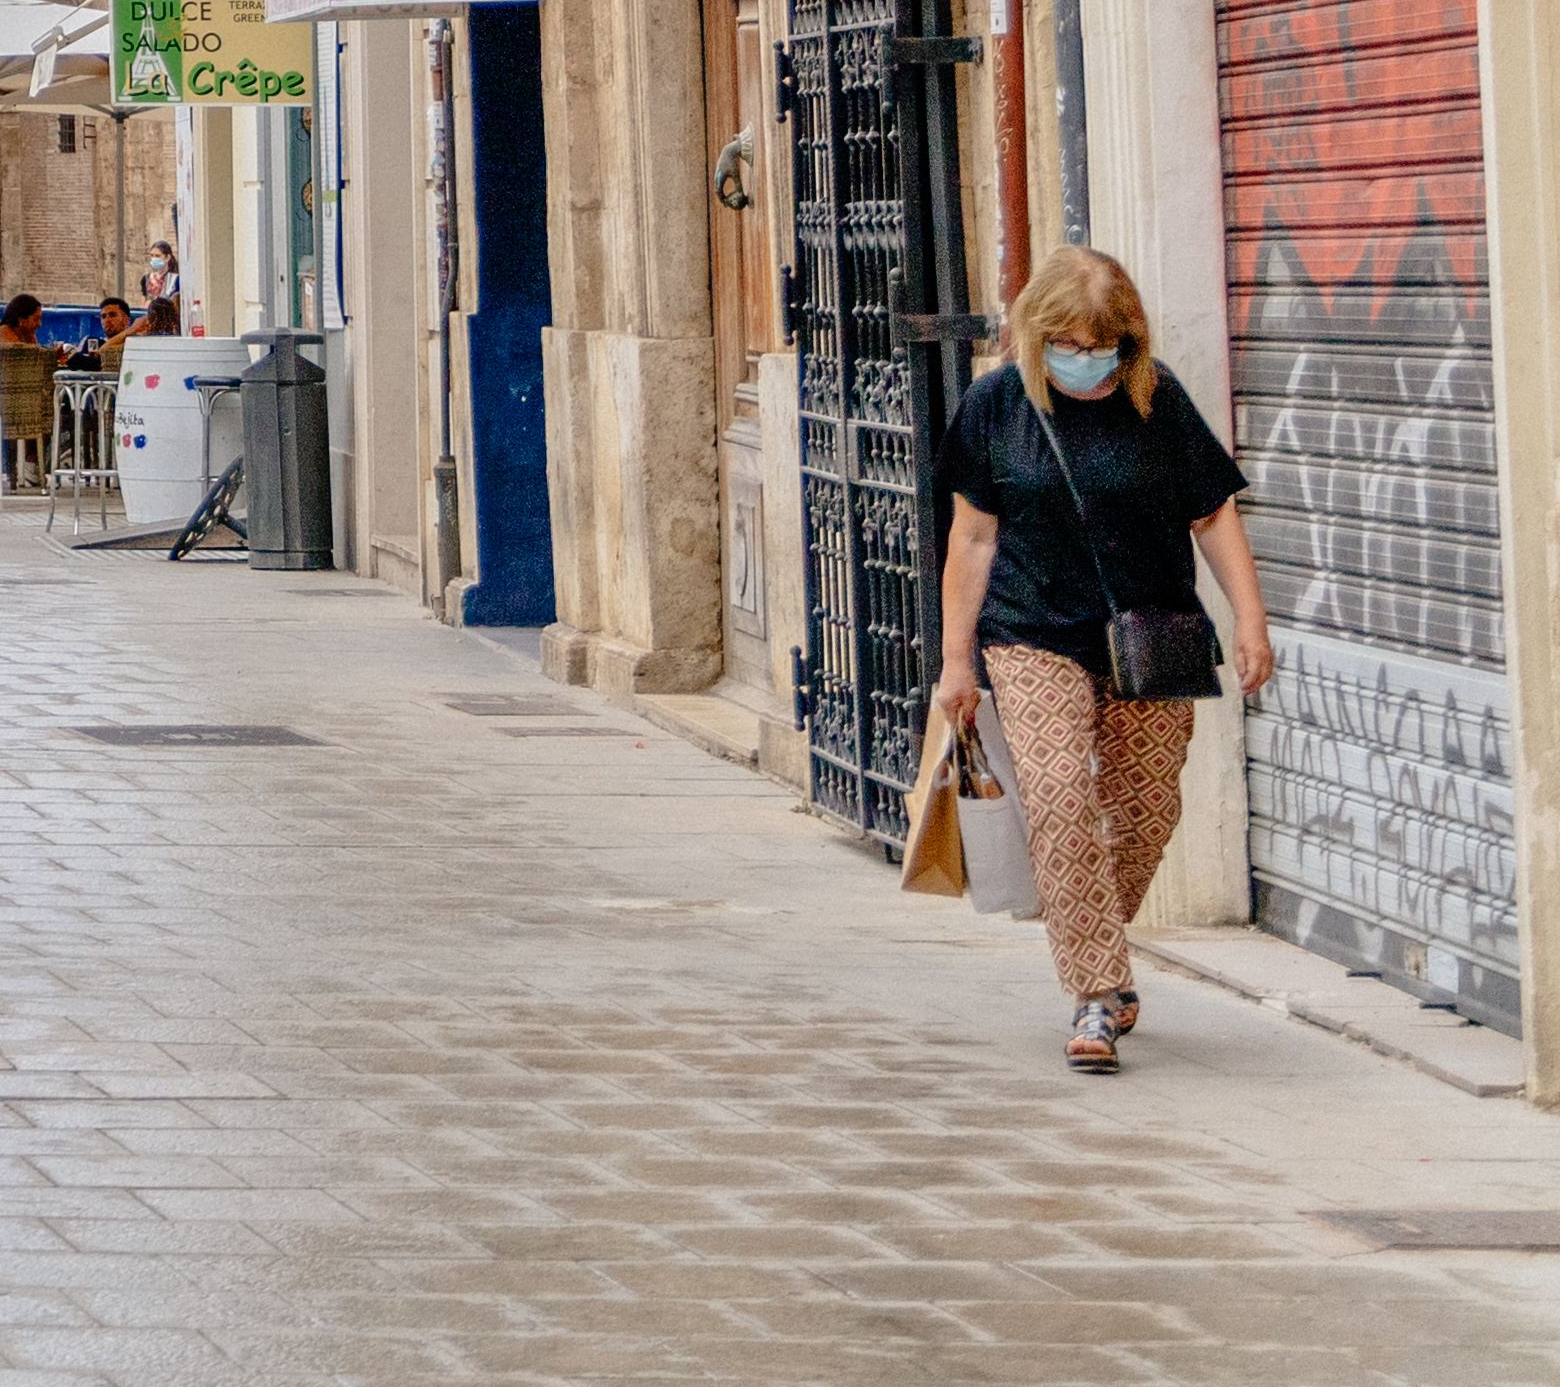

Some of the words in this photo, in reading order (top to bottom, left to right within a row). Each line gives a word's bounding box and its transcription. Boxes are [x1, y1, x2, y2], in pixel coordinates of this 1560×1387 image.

[131, 2, 212, 21] DULCE
[229, 0, 265, 10] TERRA
[122, 32, 222, 53] SALADO
[125, 59, 169, 97] La
[188, 57, 306, 103] Crêpe
